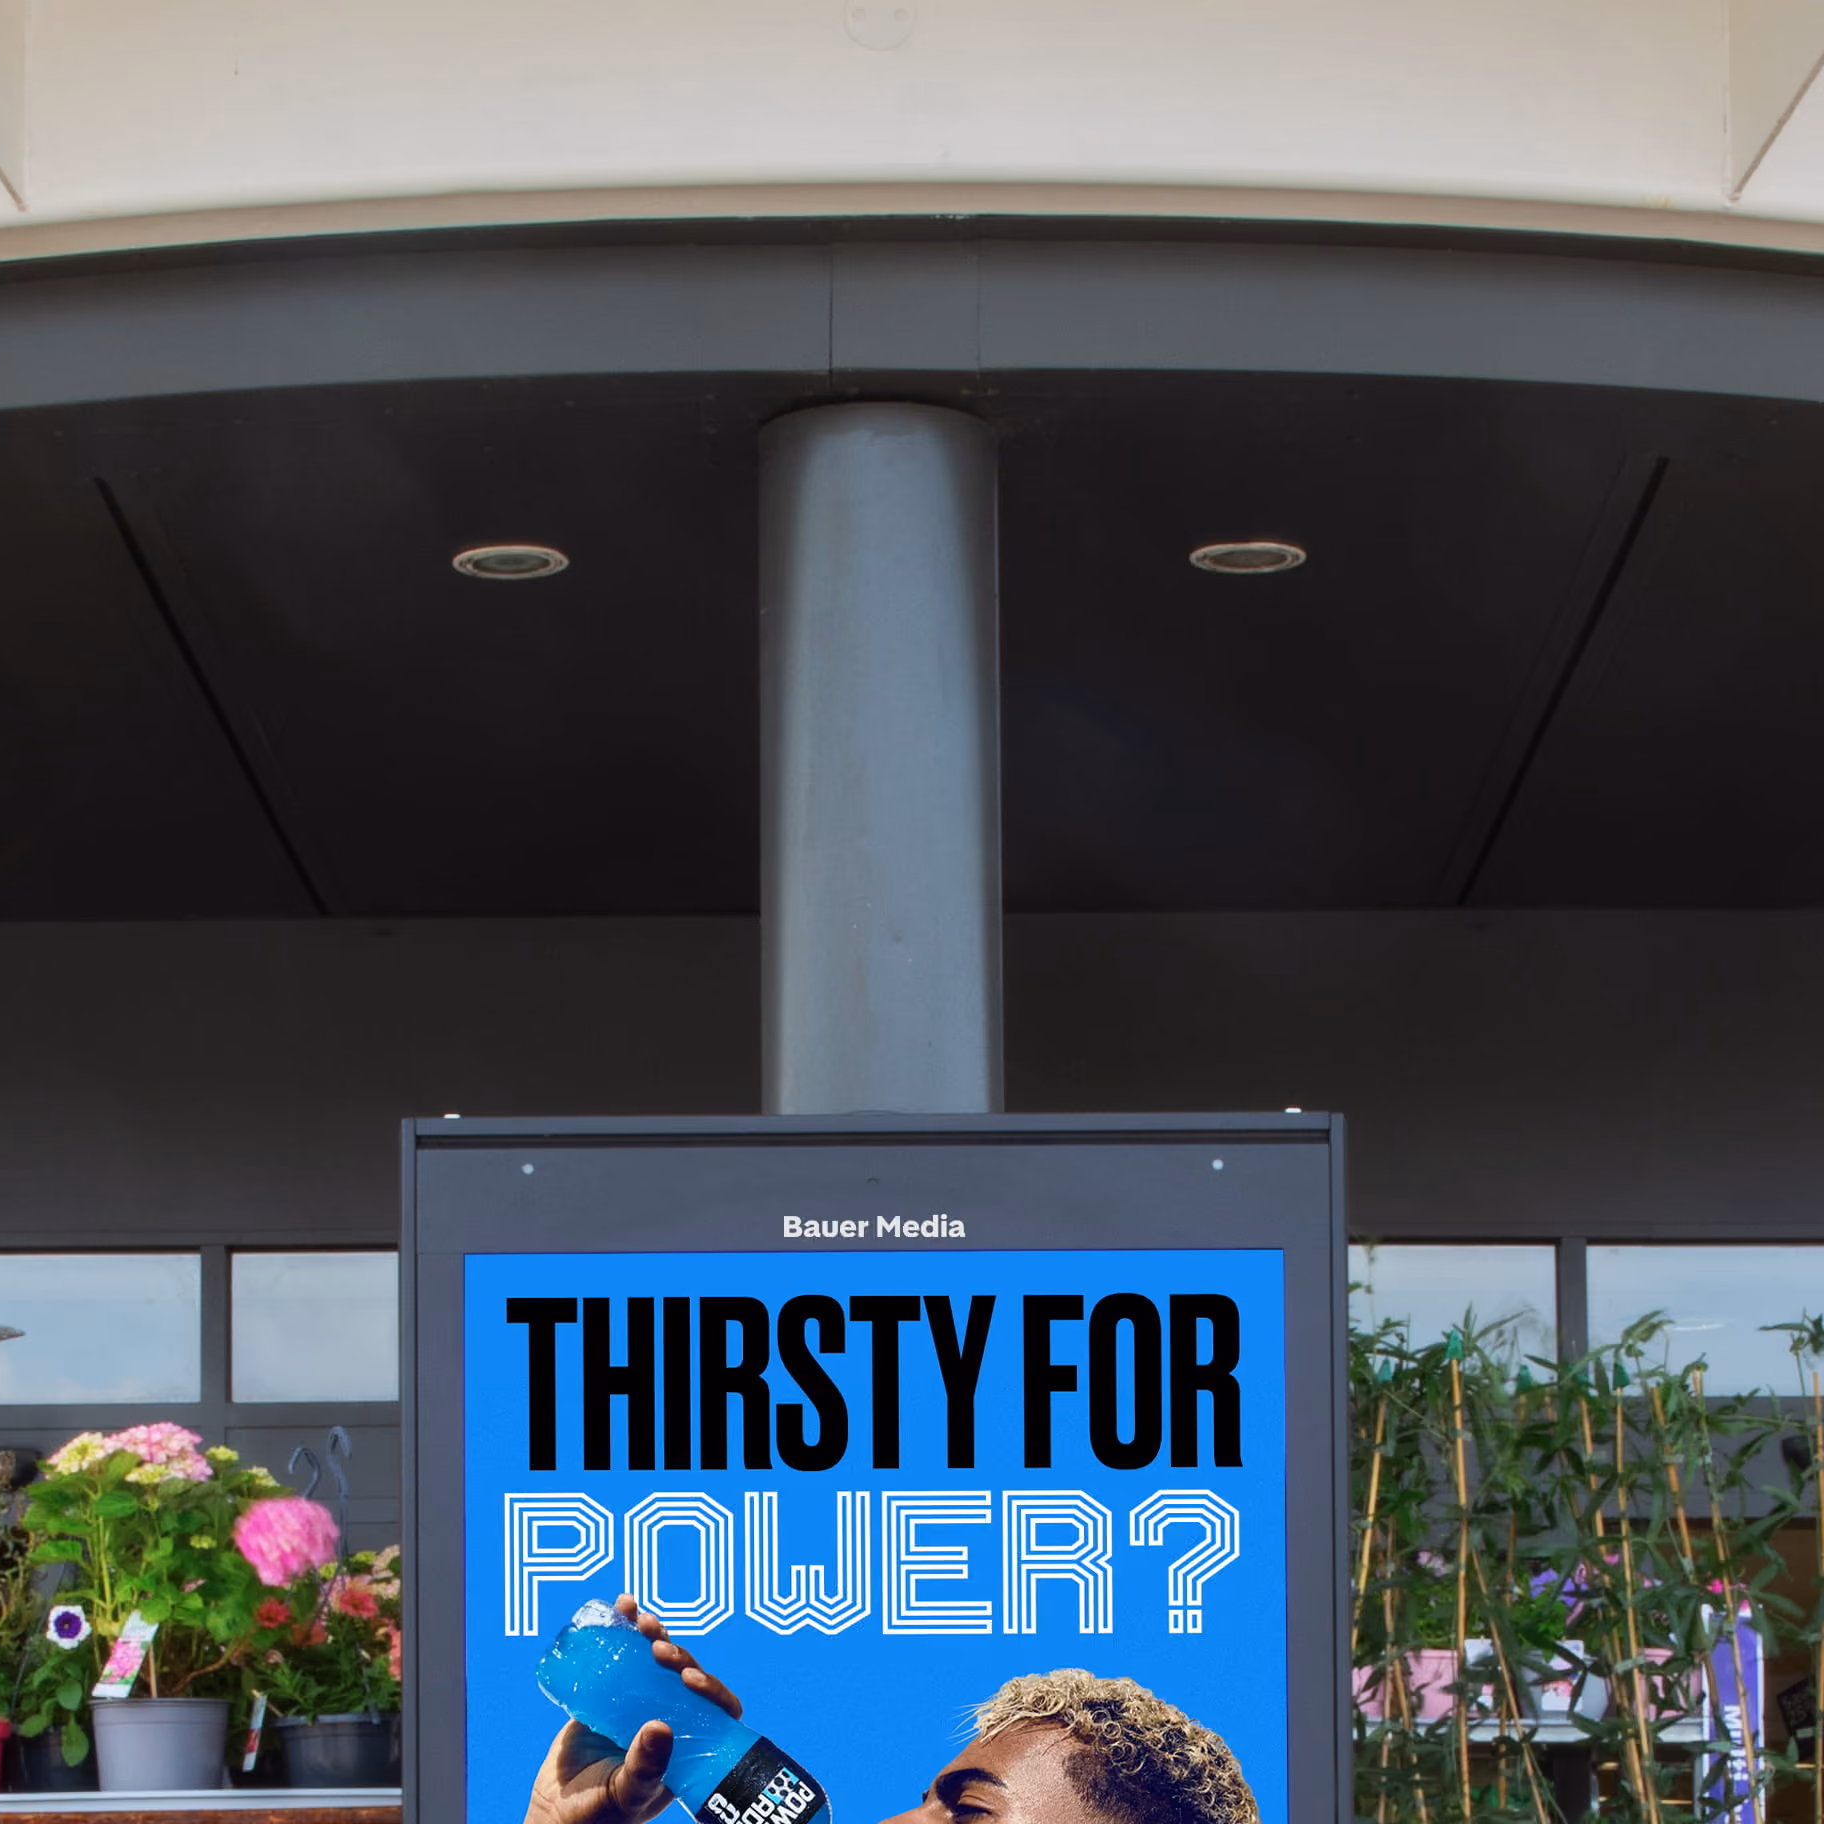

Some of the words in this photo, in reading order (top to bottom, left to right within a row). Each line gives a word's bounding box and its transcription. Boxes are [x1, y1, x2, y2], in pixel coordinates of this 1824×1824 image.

[782, 1214, 869, 1239] Bauer
[876, 1213, 966, 1239] Media
[505, 1294, 997, 1472] THIRSTY
[1022, 1292, 1244, 1470] FOR
[503, 1488, 1240, 1638] POWER?
